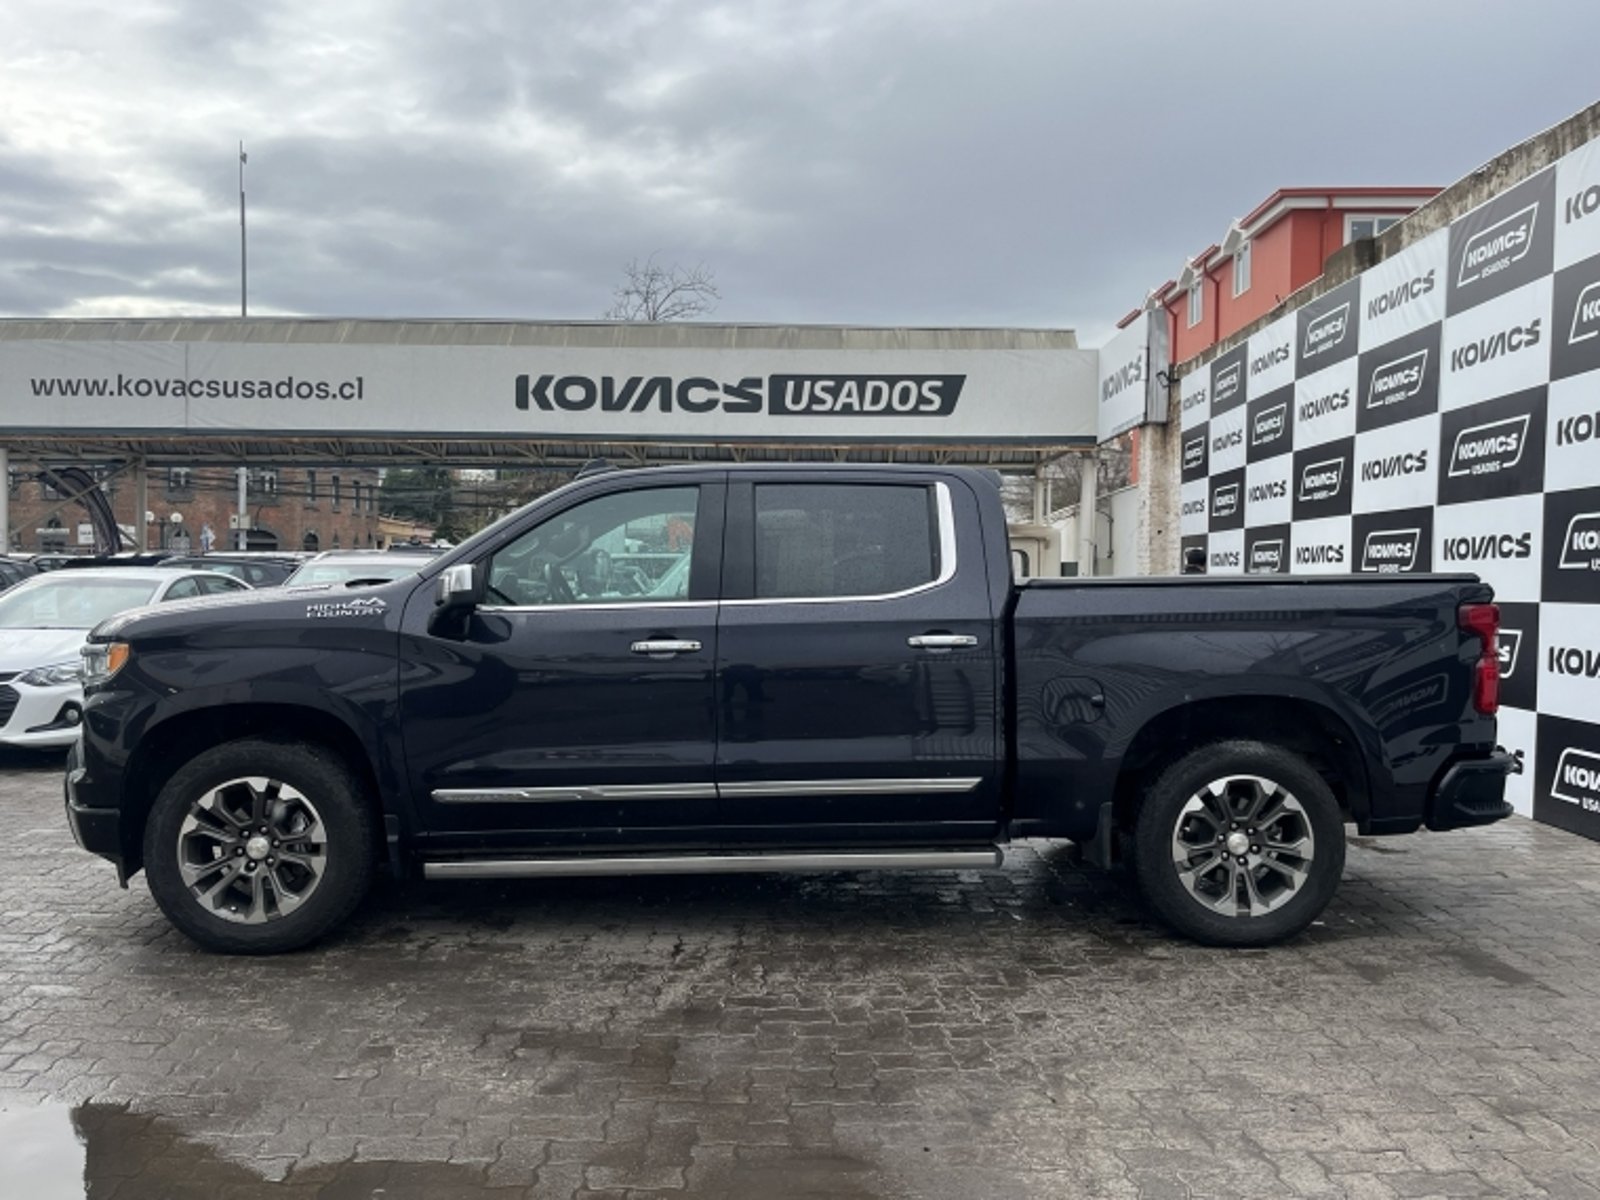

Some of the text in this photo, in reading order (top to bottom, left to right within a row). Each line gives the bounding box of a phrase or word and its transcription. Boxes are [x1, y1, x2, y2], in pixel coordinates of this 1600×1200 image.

[1467, 224, 1526, 268] KOVACS
[1368, 269, 1435, 320] KOVACS
[1450, 317, 1541, 372] KOVACS
[31, 374, 364, 400] www.kovacsusados.cl
[515, 374, 944, 413] KOVACS USADOS
[1374, 366, 1419, 393] KOVACS
[1299, 387, 1349, 421] KOVACS
[1557, 410, 1600, 446] KO
[1458, 432, 1519, 460] KOVACS
[1361, 449, 1428, 482] KOVACS
[1296, 544, 1344, 564] KOVACS
[1367, 542, 1412, 558] KOVACS
[1443, 532, 1532, 561] KOVACS
[1572, 530, 1600, 550] KO
[1548, 646, 1600, 678] KOV
[1564, 764, 1600, 792] KOV
